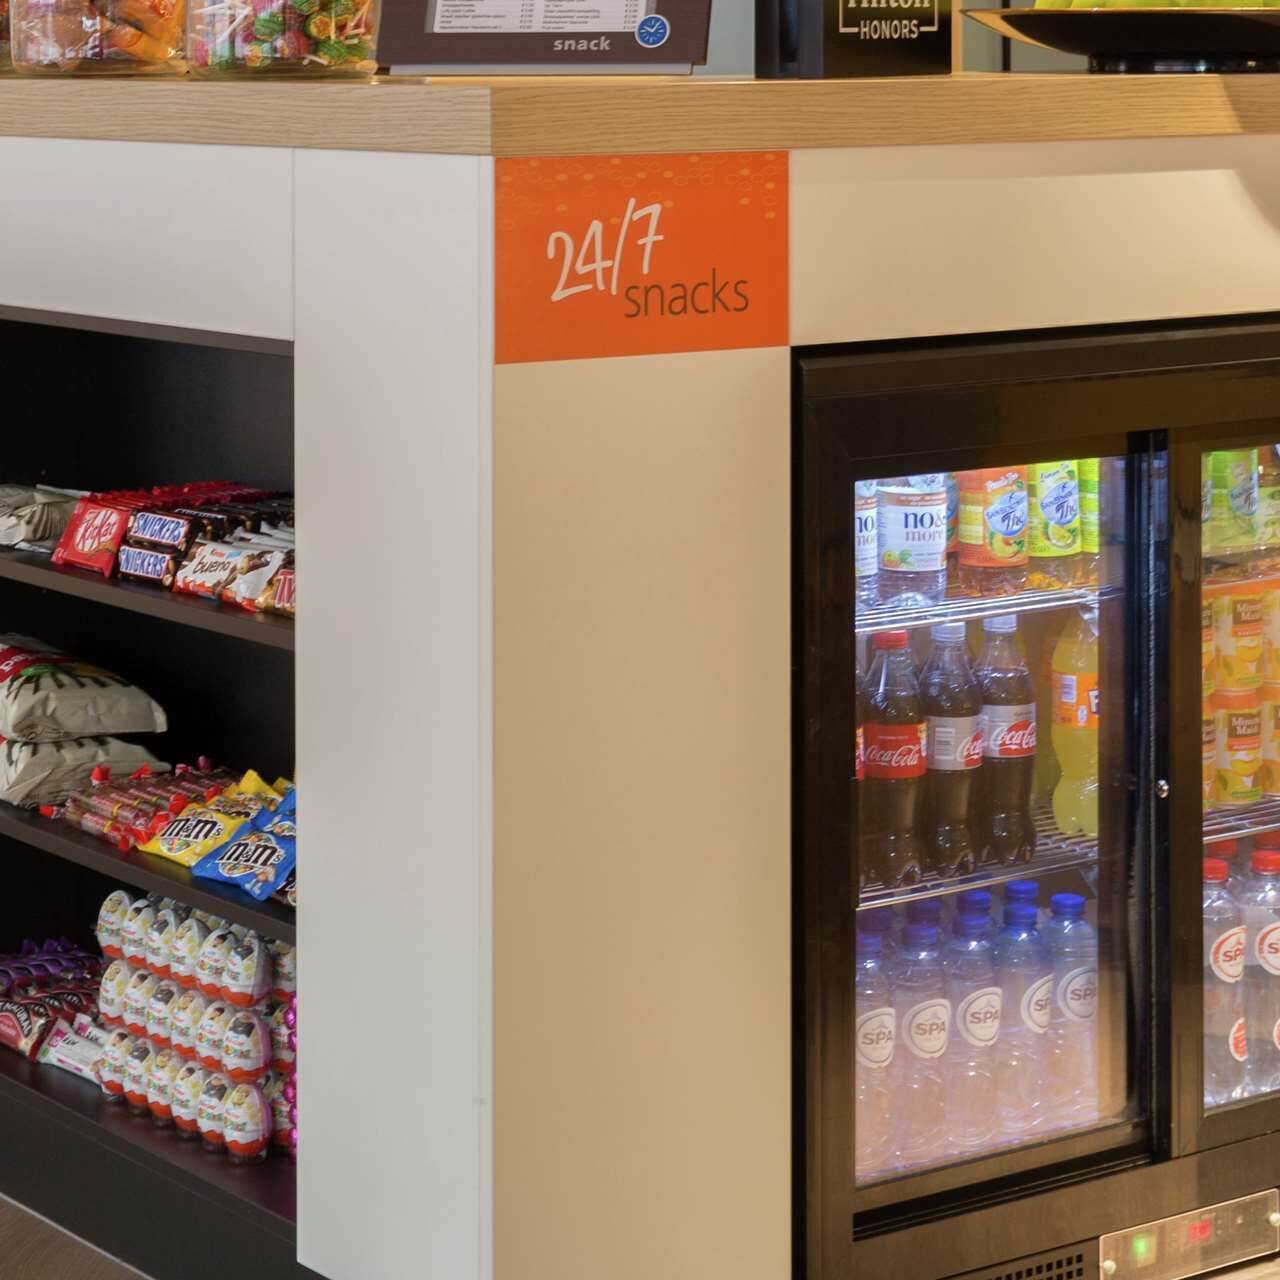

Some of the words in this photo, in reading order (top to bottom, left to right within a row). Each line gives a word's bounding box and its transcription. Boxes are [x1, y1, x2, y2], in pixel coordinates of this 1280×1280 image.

[860, 19, 919, 40] HONORS
[553, 35, 611, 51] snack
[546, 197, 665, 302] 24/7
[624, 267, 750, 318] snacks
[133, 512, 185, 543] SNICKERS
[193, 555, 232, 574] bueno
[3, 1002, 32, 1037] NATURAL
[915, 1021, 946, 1037] SPA
[861, 1030, 893, 1046] SPA
